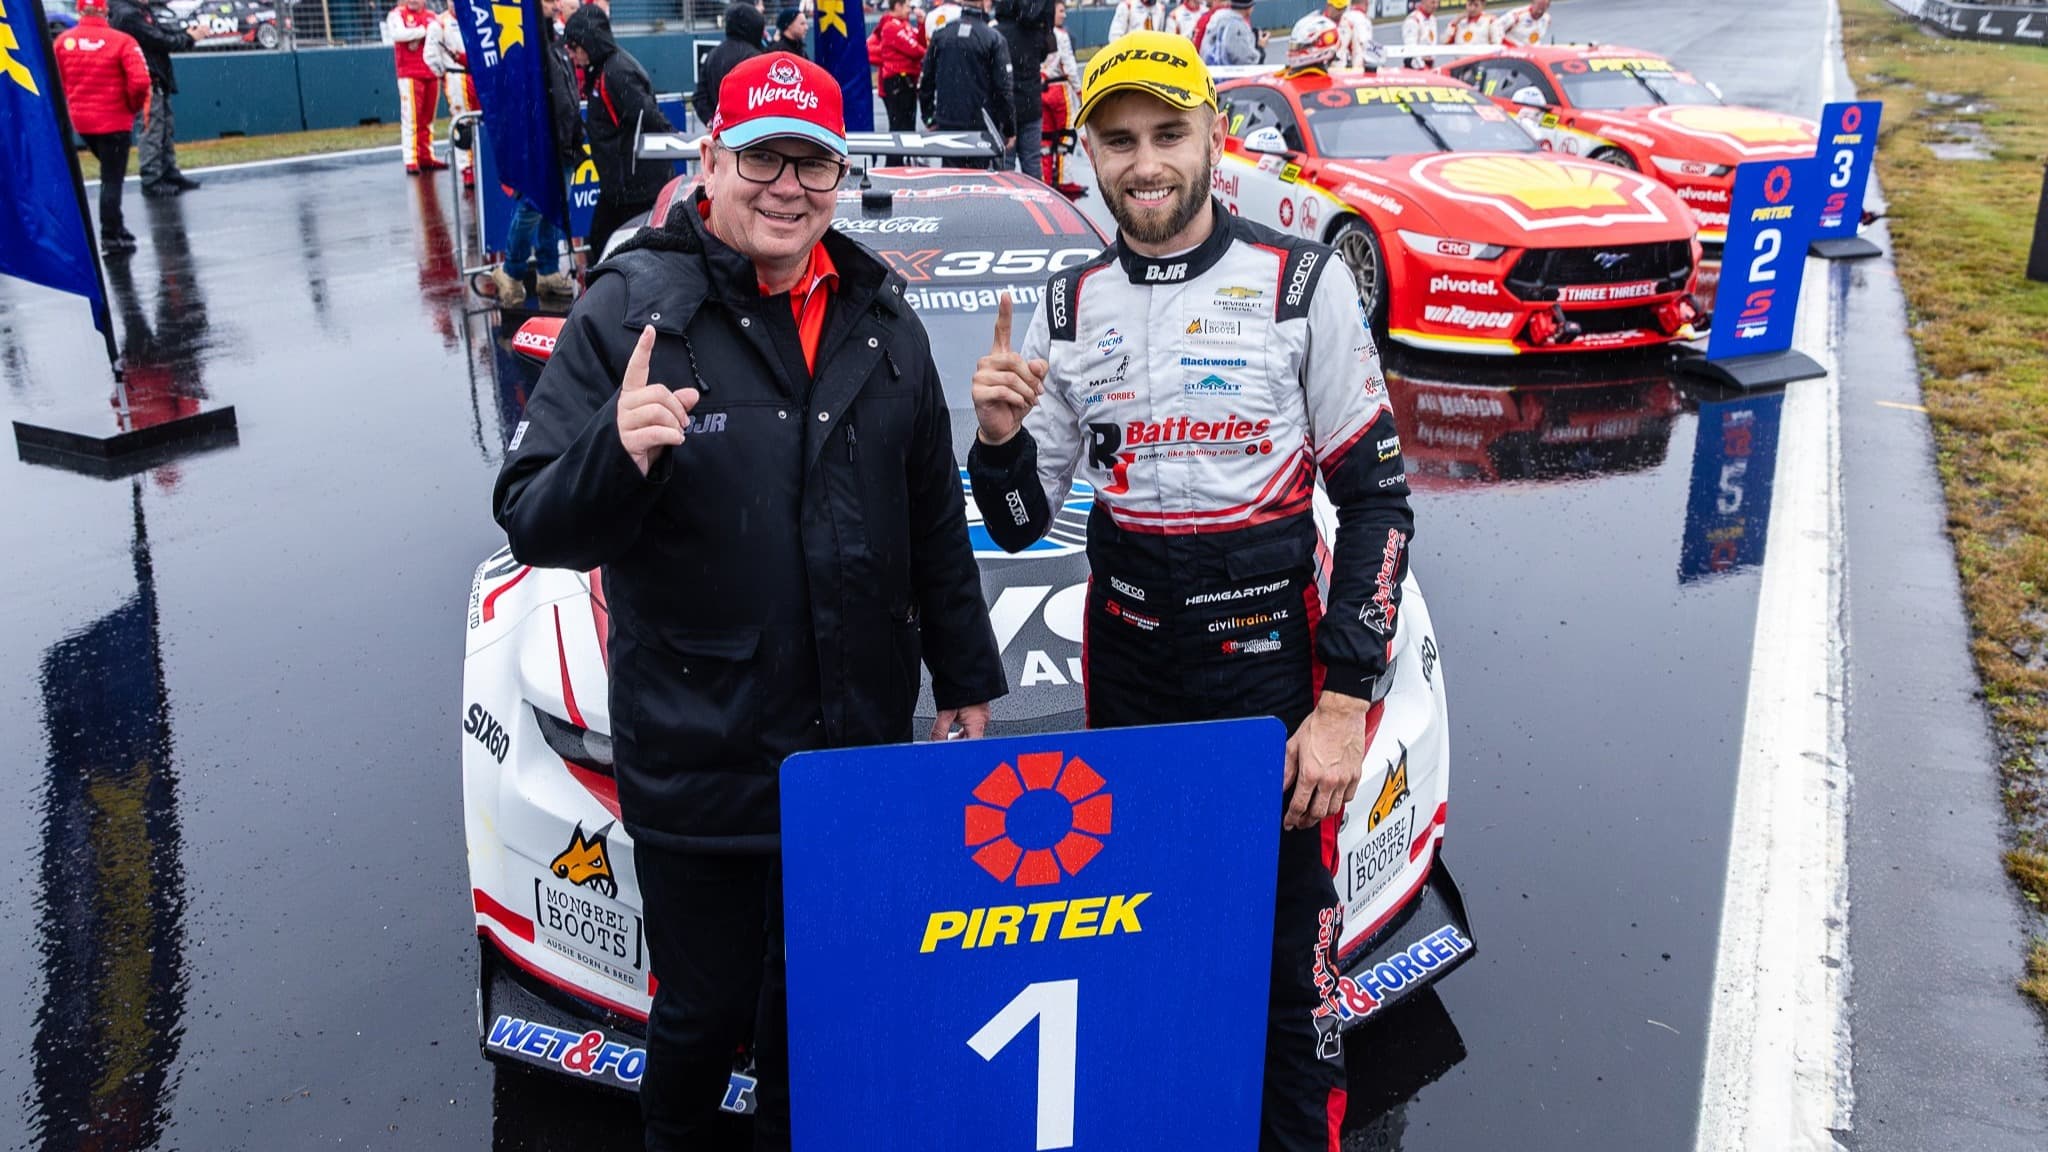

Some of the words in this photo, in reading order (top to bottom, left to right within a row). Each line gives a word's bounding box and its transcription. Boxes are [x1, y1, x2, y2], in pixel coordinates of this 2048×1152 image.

[469, 0, 498, 68] ANE
[1087, 49, 1188, 91] DUNLOP
[748, 82, 818, 110] Wendy's
[1355, 86, 1477, 105] PIRTEK
[1212, 168, 1239, 198] Shell
[1830, 149, 1855, 188] 3
[574, 189, 600, 208] VIC
[1438, 241, 1470, 255] CRC
[1748, 228, 1782, 283] 2
[1145, 263, 1188, 281] BJR
[1286, 252, 1319, 306] sparco
[1430, 275, 1498, 296] pivotel.
[1053, 278, 1067, 329] sparco
[1568, 286, 1607, 301] THREE
[1609, 284, 1649, 299] THREES
[1444, 305, 1514, 329] Repco
[1097, 335, 1125, 350] FUCHS
[1180, 357, 1247, 367] Blackwoods
[1089, 375, 1125, 388] MACK
[1107, 391, 1136, 401] FORBES
[1125, 414, 1270, 445] Batteries
[1111, 576, 1145, 601] sparco
[1185, 579, 1290, 606] HEIMGARTNER
[1208, 609, 1289, 633] civiltrain.nz
[463, 702, 510, 764] SIX60
[1355, 816, 1408, 867] MONGREL
[1355, 834, 1405, 892] BOOTS
[546, 887, 629, 933] MONGREL
[919, 892, 1152, 953] PIRTEK
[548, 905, 627, 958] BOOTS
[546, 938, 575, 958] AUSSIE
[577, 949, 601, 969] BORN
[612, 967, 635, 985] BRED
[966, 978, 1078, 1151] 1
